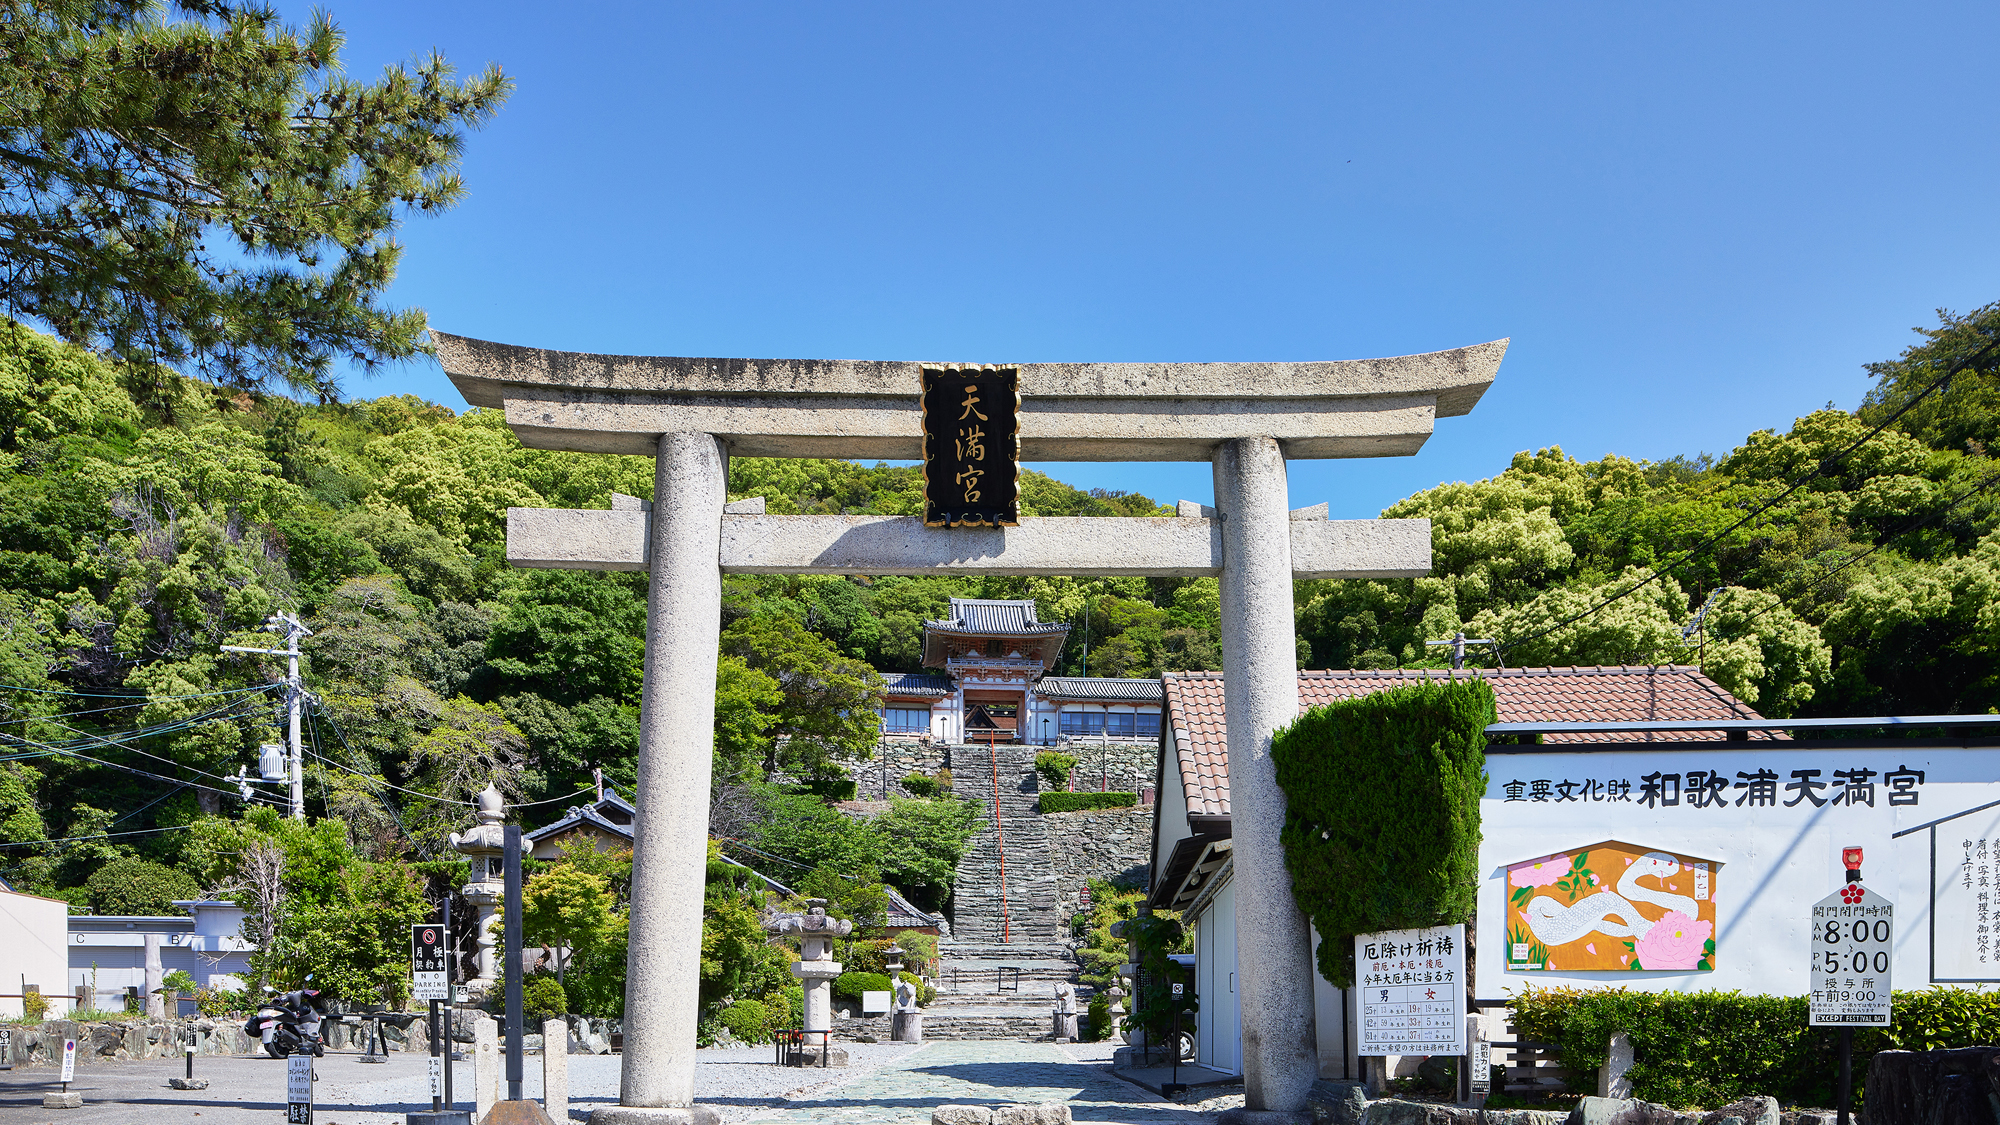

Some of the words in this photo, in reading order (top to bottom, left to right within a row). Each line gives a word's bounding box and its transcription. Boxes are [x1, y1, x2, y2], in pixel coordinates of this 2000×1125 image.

[955, 384, 989, 503] 天満宮
[1502, 778, 1632, 803] 重要文化財
[1637, 765, 1926, 809] 和歌浦天満宮
[1961, 838, 1974, 890] 申し上げます
[1695, 863, 1708, 899] 令和乙巳
[1813, 905, 1892, 918] 開門閉門時間
[76, 933, 85, 944] C
[1824, 920, 1890, 944] 8:00
[171, 935, 180, 945] B
[235, 940, 245, 950] A
[1362, 935, 1454, 960] 厄除け祈祷
[415, 958, 445, 971] 契約車
[1372, 958, 1444, 972] 前厄・本厄・後厄
[1825, 950, 1889, 974] 5:00
[1363, 970, 1455, 986] 今年大厄年に当る方
[1825, 978, 1875, 989] 授与所
[1380, 989, 1389, 1002] 男
[1424, 988, 1436, 1000] 女
[1816, 1014, 1843, 1022] EXCEPT
[1846, 1014, 1872, 1022] FESTIVAL
[1874, 1014, 1885, 1022] DAY
[1480, 1043, 1489, 1080] 防犯カメラ
